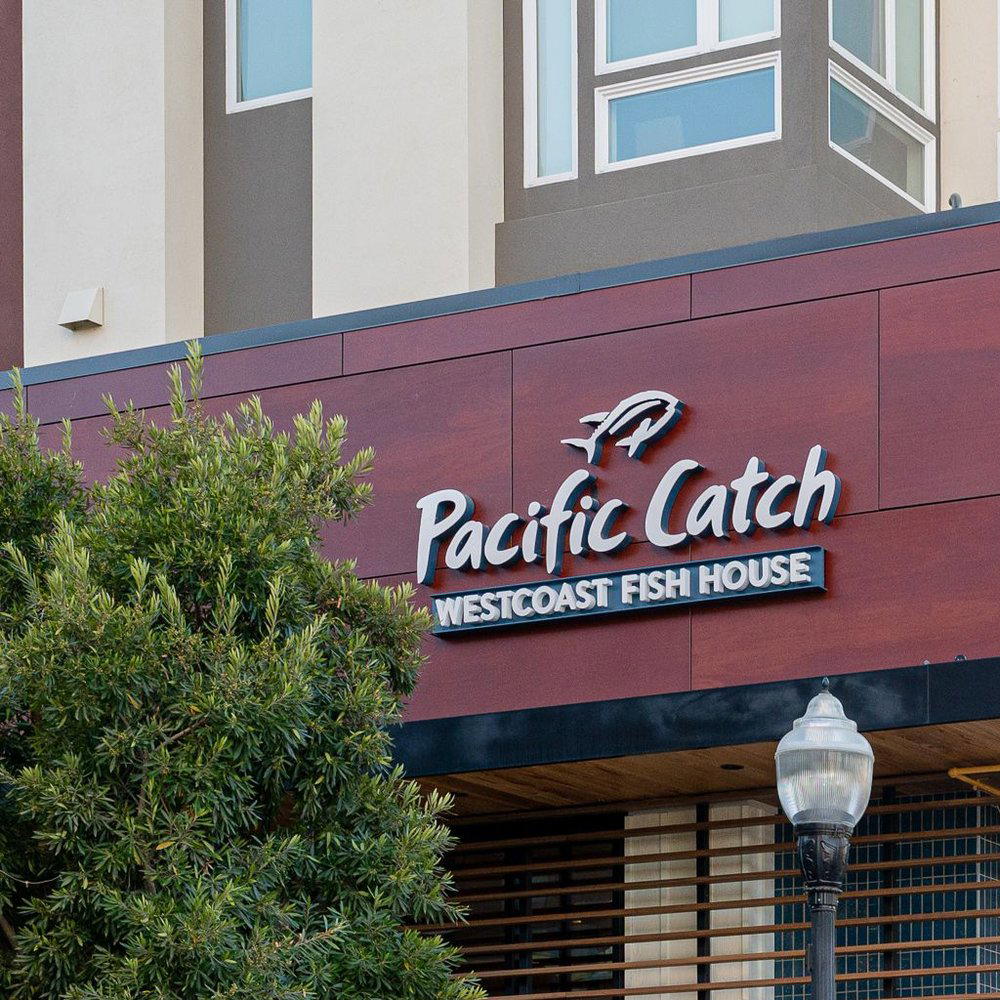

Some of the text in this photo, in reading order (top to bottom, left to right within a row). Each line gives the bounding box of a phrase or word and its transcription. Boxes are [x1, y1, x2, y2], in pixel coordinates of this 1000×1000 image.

[416, 444, 839, 584] Pacific Catch
[435, 552, 811, 627] WESTCOAST FISH HOUSE
